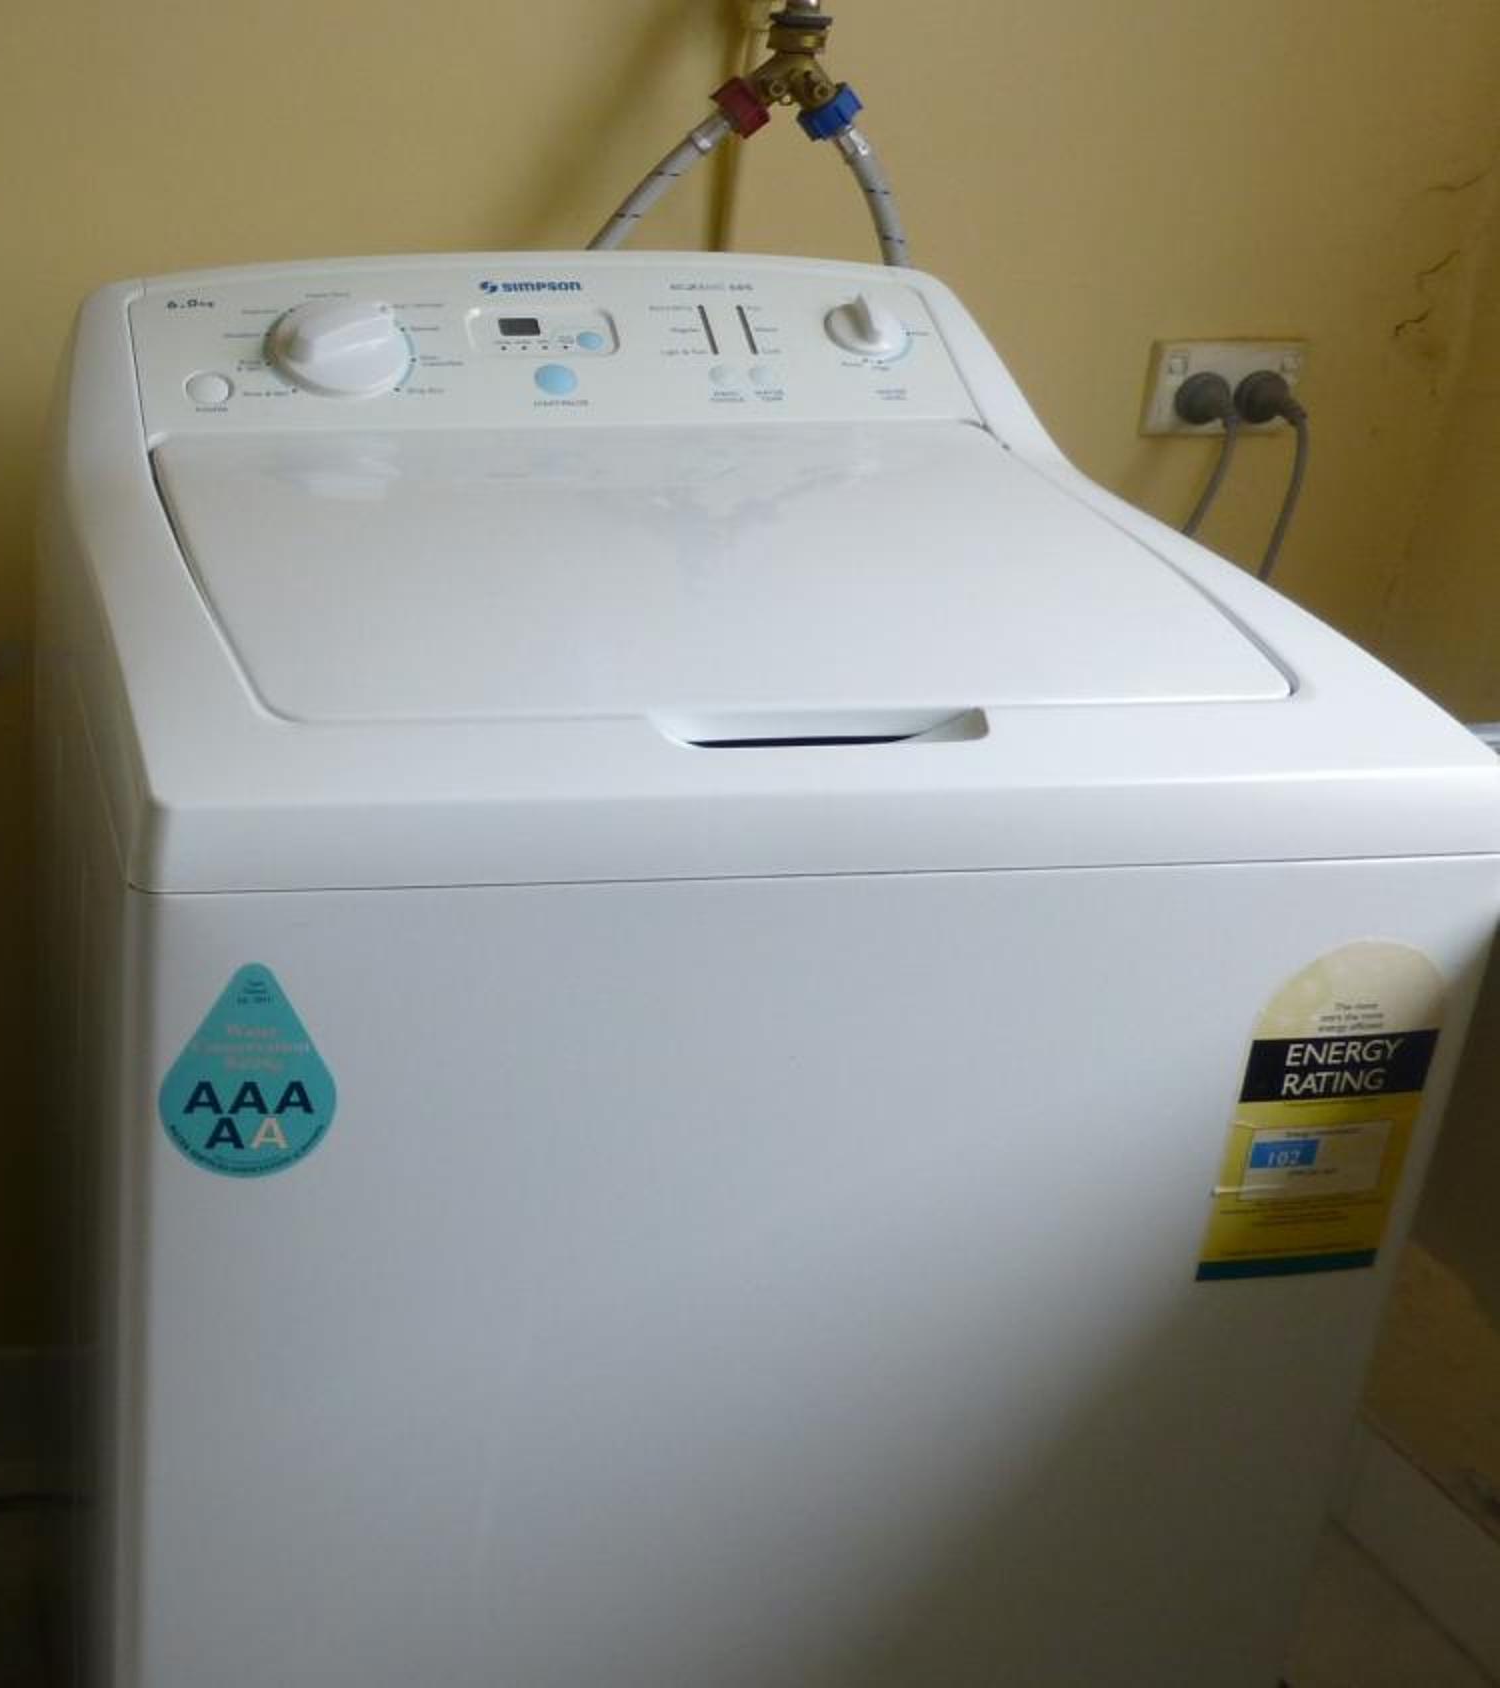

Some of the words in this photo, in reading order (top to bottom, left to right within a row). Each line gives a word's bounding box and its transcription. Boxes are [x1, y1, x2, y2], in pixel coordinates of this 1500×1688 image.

[501, 280, 583, 293] SIMPSON
[1285, 1039, 1404, 1068] ENERGY
[1281, 1068, 1386, 1096] RATING
